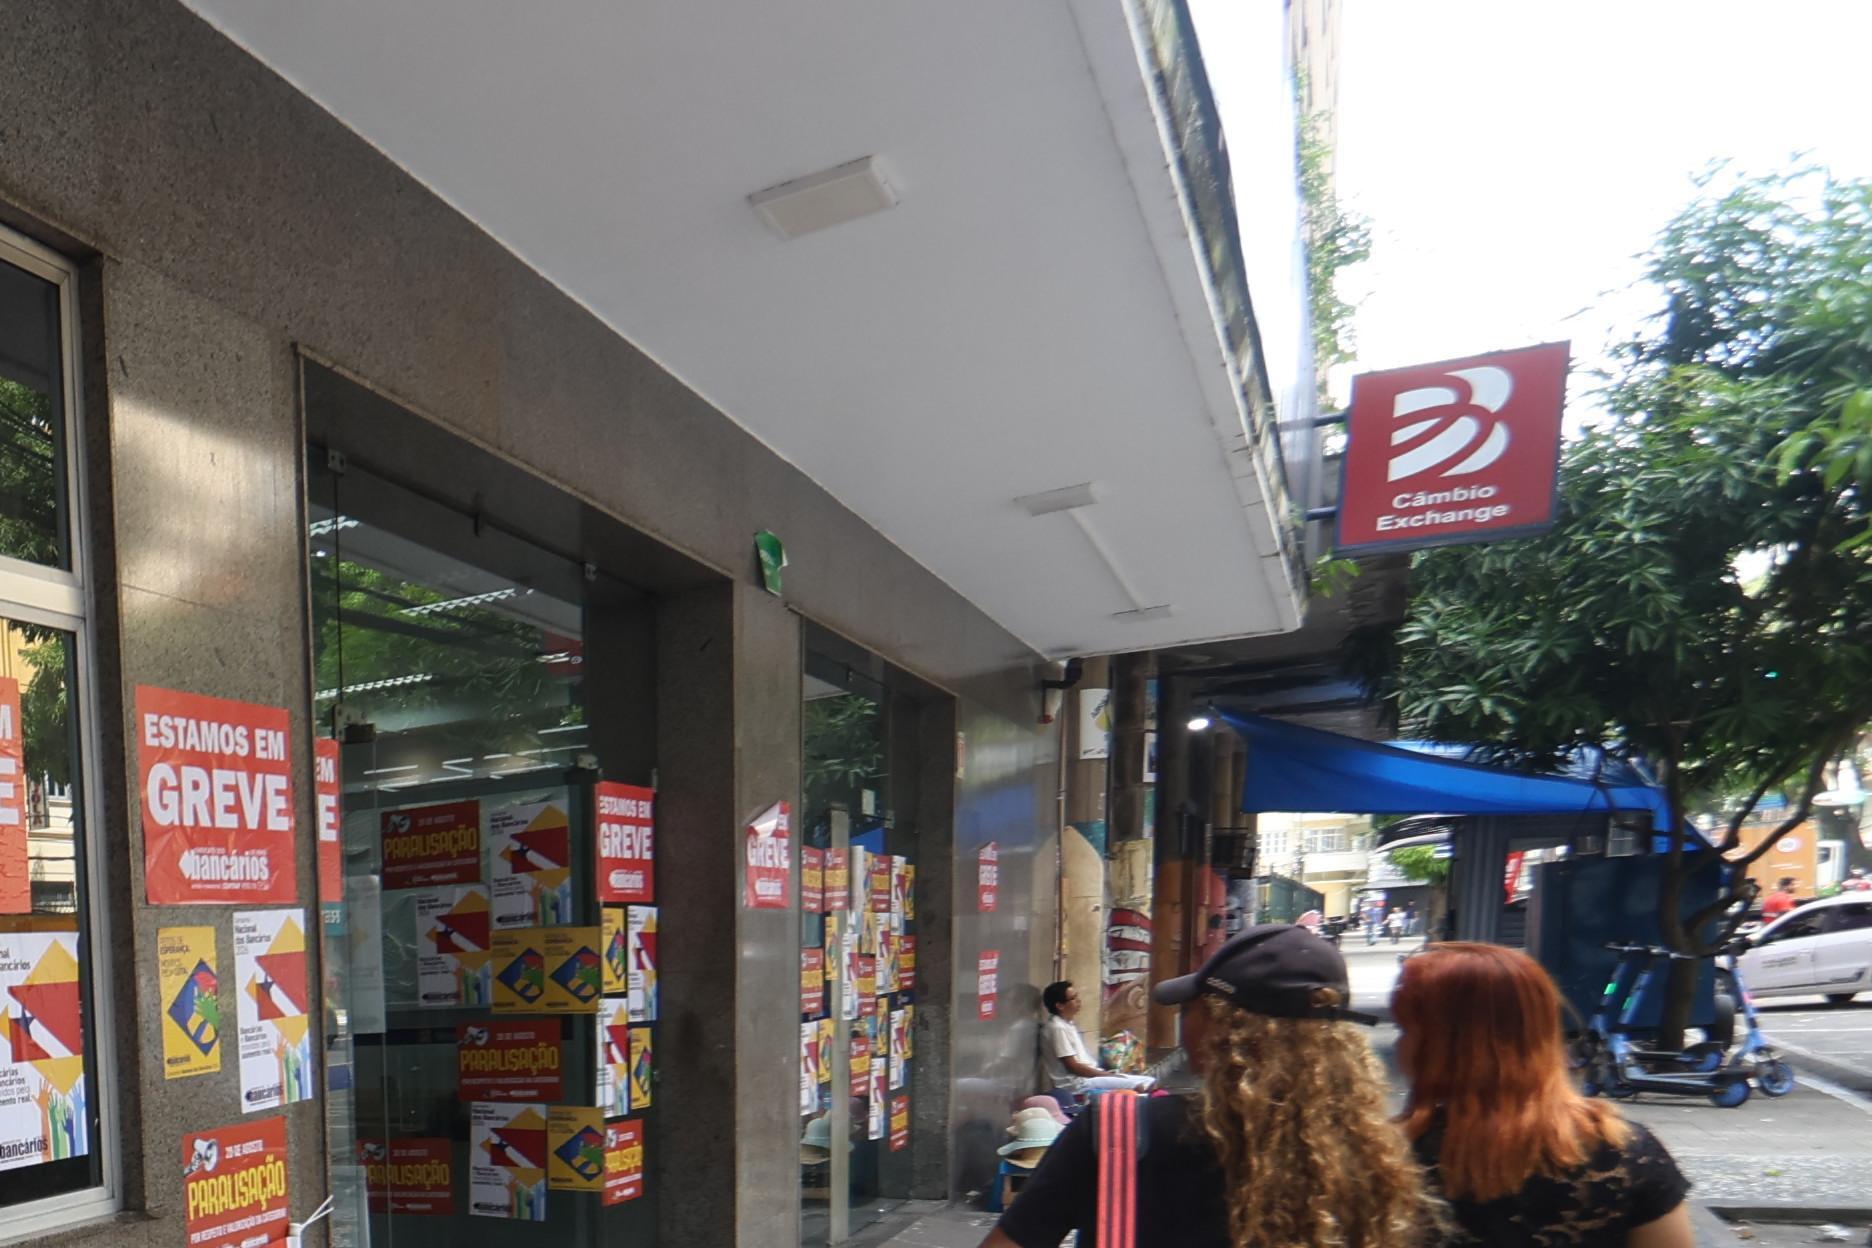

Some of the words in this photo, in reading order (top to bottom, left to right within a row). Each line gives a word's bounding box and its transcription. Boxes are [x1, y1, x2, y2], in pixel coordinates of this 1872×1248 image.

[1376, 504, 1509, 531] Exchange
[144, 713, 248, 757] ESTAMOS
[254, 728, 285, 761] EM
[147, 763, 289, 831] GREVE
[600, 822, 652, 859] GREVE
[191, 850, 269, 881] bancários
[188, 1153, 285, 1221] PARALISAÇÃO
